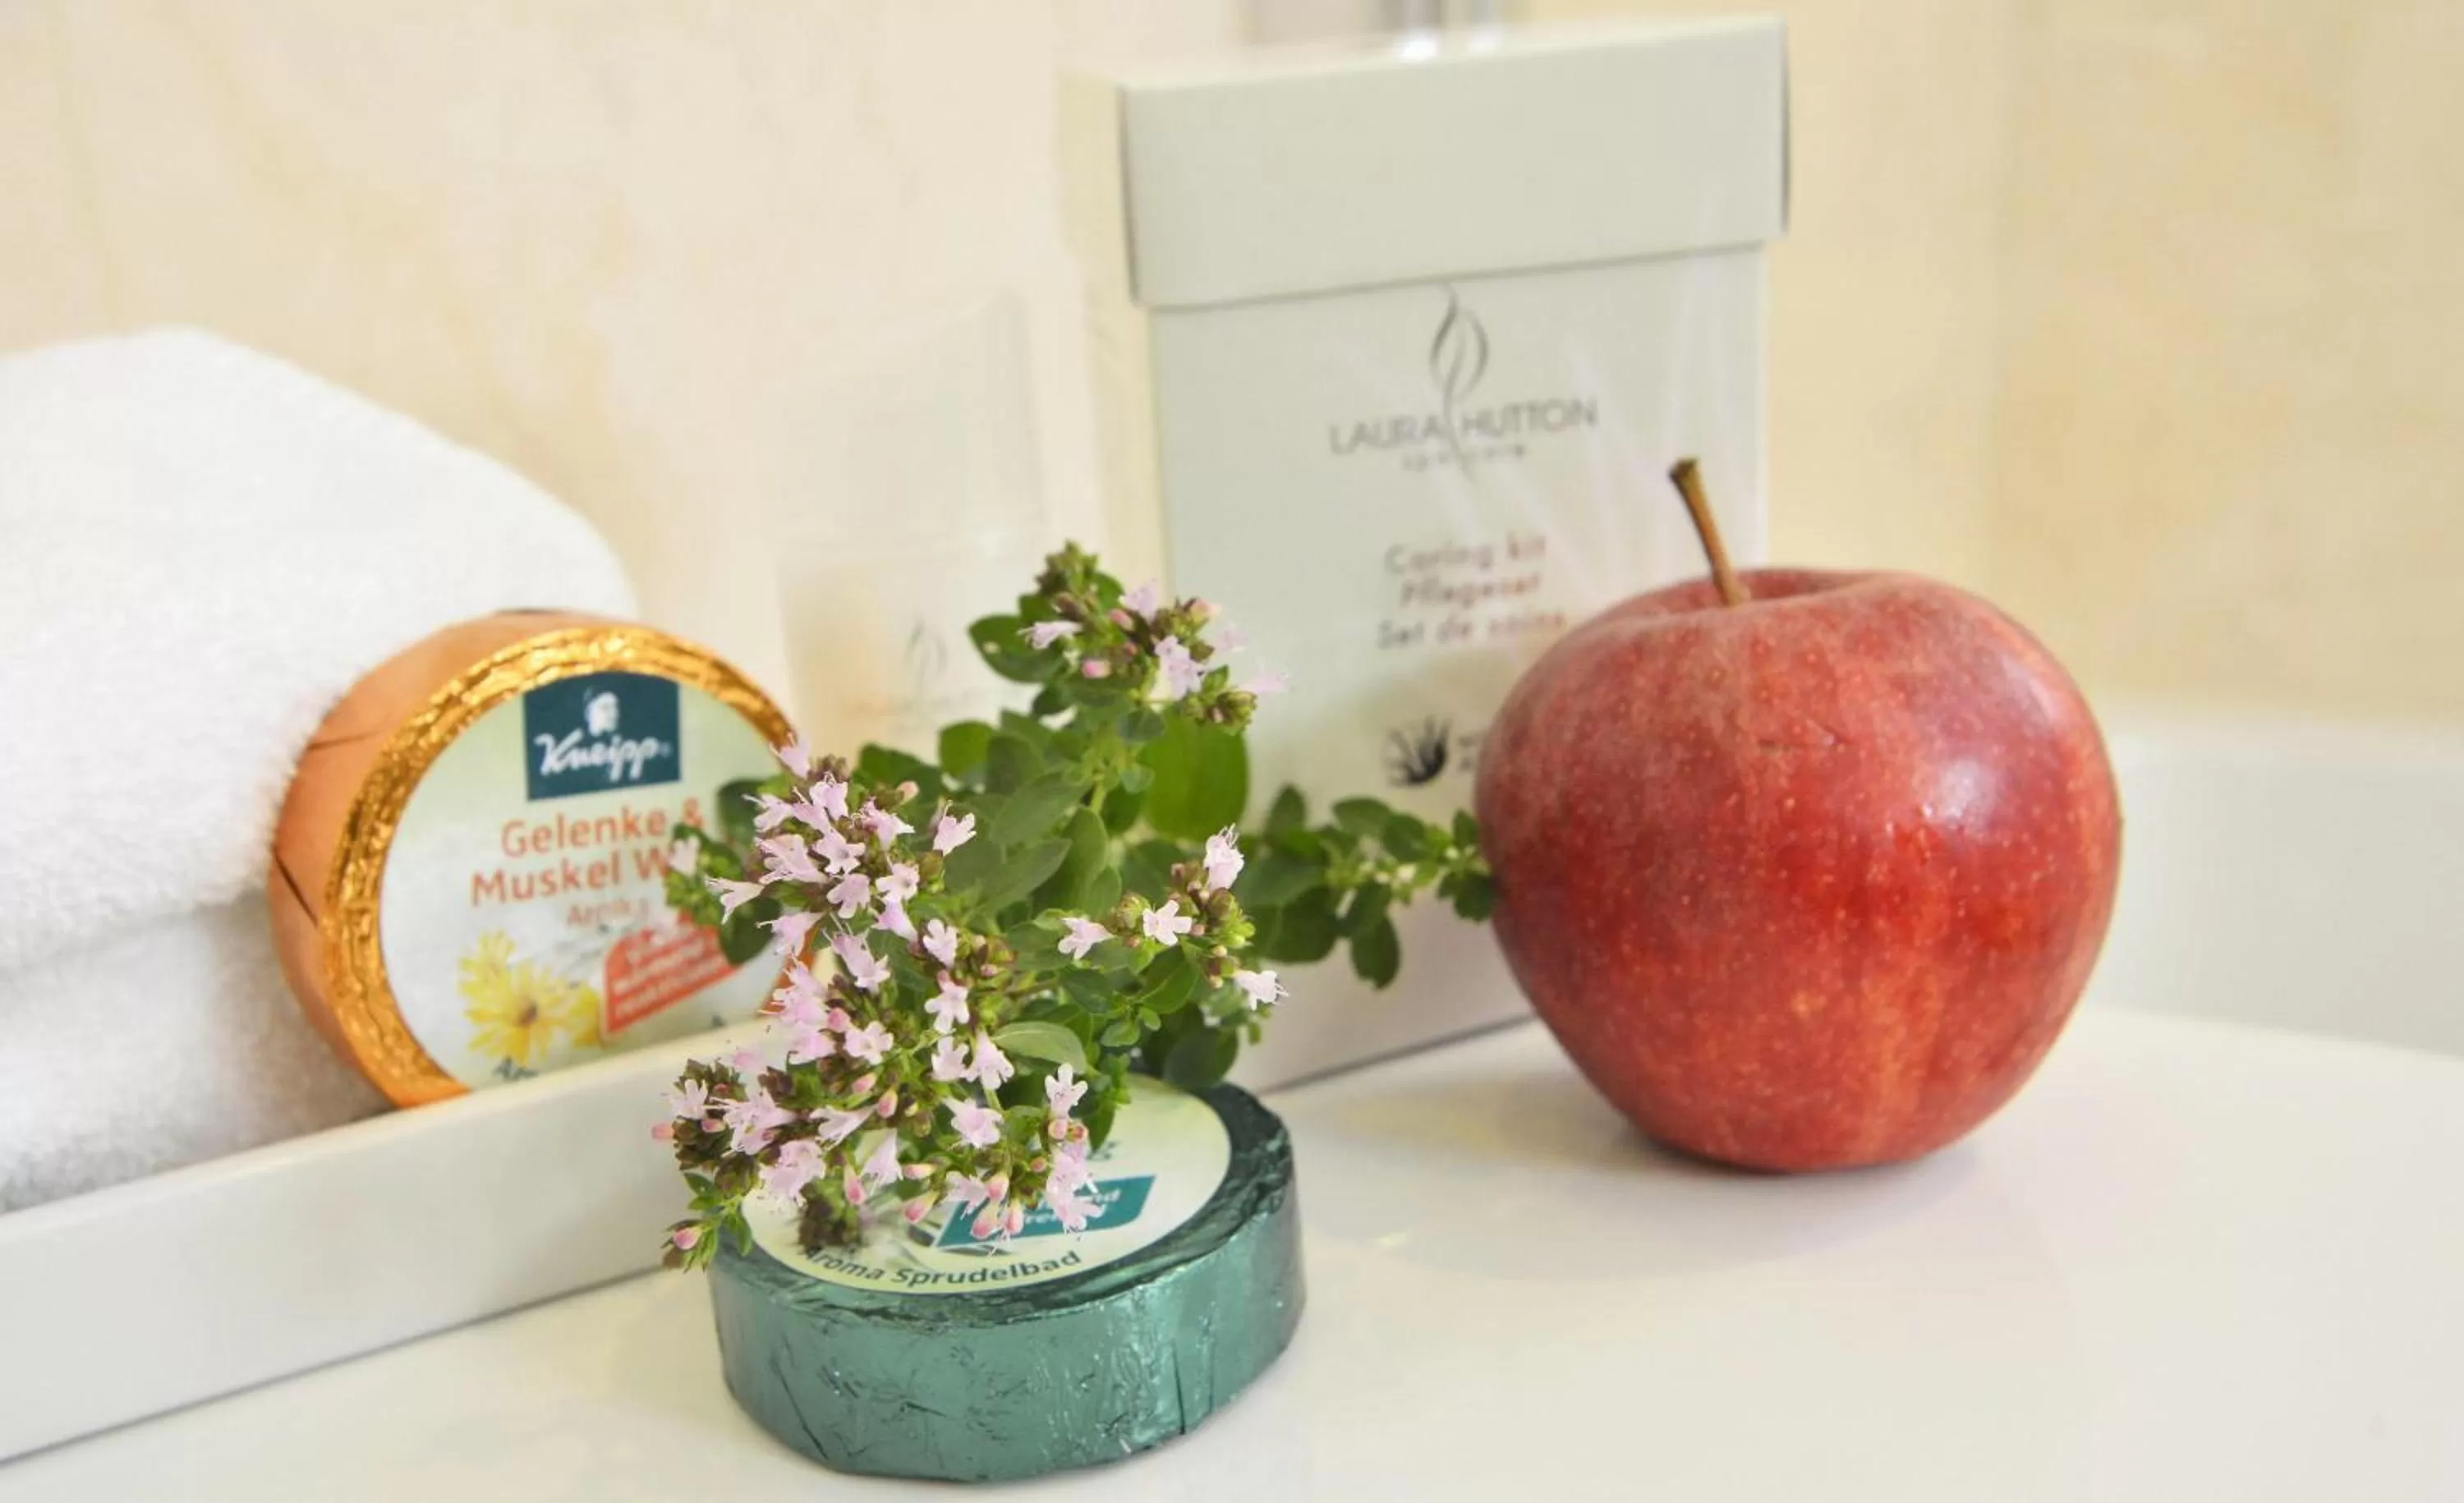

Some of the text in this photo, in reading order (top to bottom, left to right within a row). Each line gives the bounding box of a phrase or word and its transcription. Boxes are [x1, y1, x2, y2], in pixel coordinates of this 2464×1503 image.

[1328, 397, 1598, 455] LAURA HUTTON
[535, 728, 661, 783] Kneipp
[501, 802, 667, 859] Gelenke
[471, 849, 621, 908] Muskel
[891, 1249, 1081, 1288] Sprudelbad
